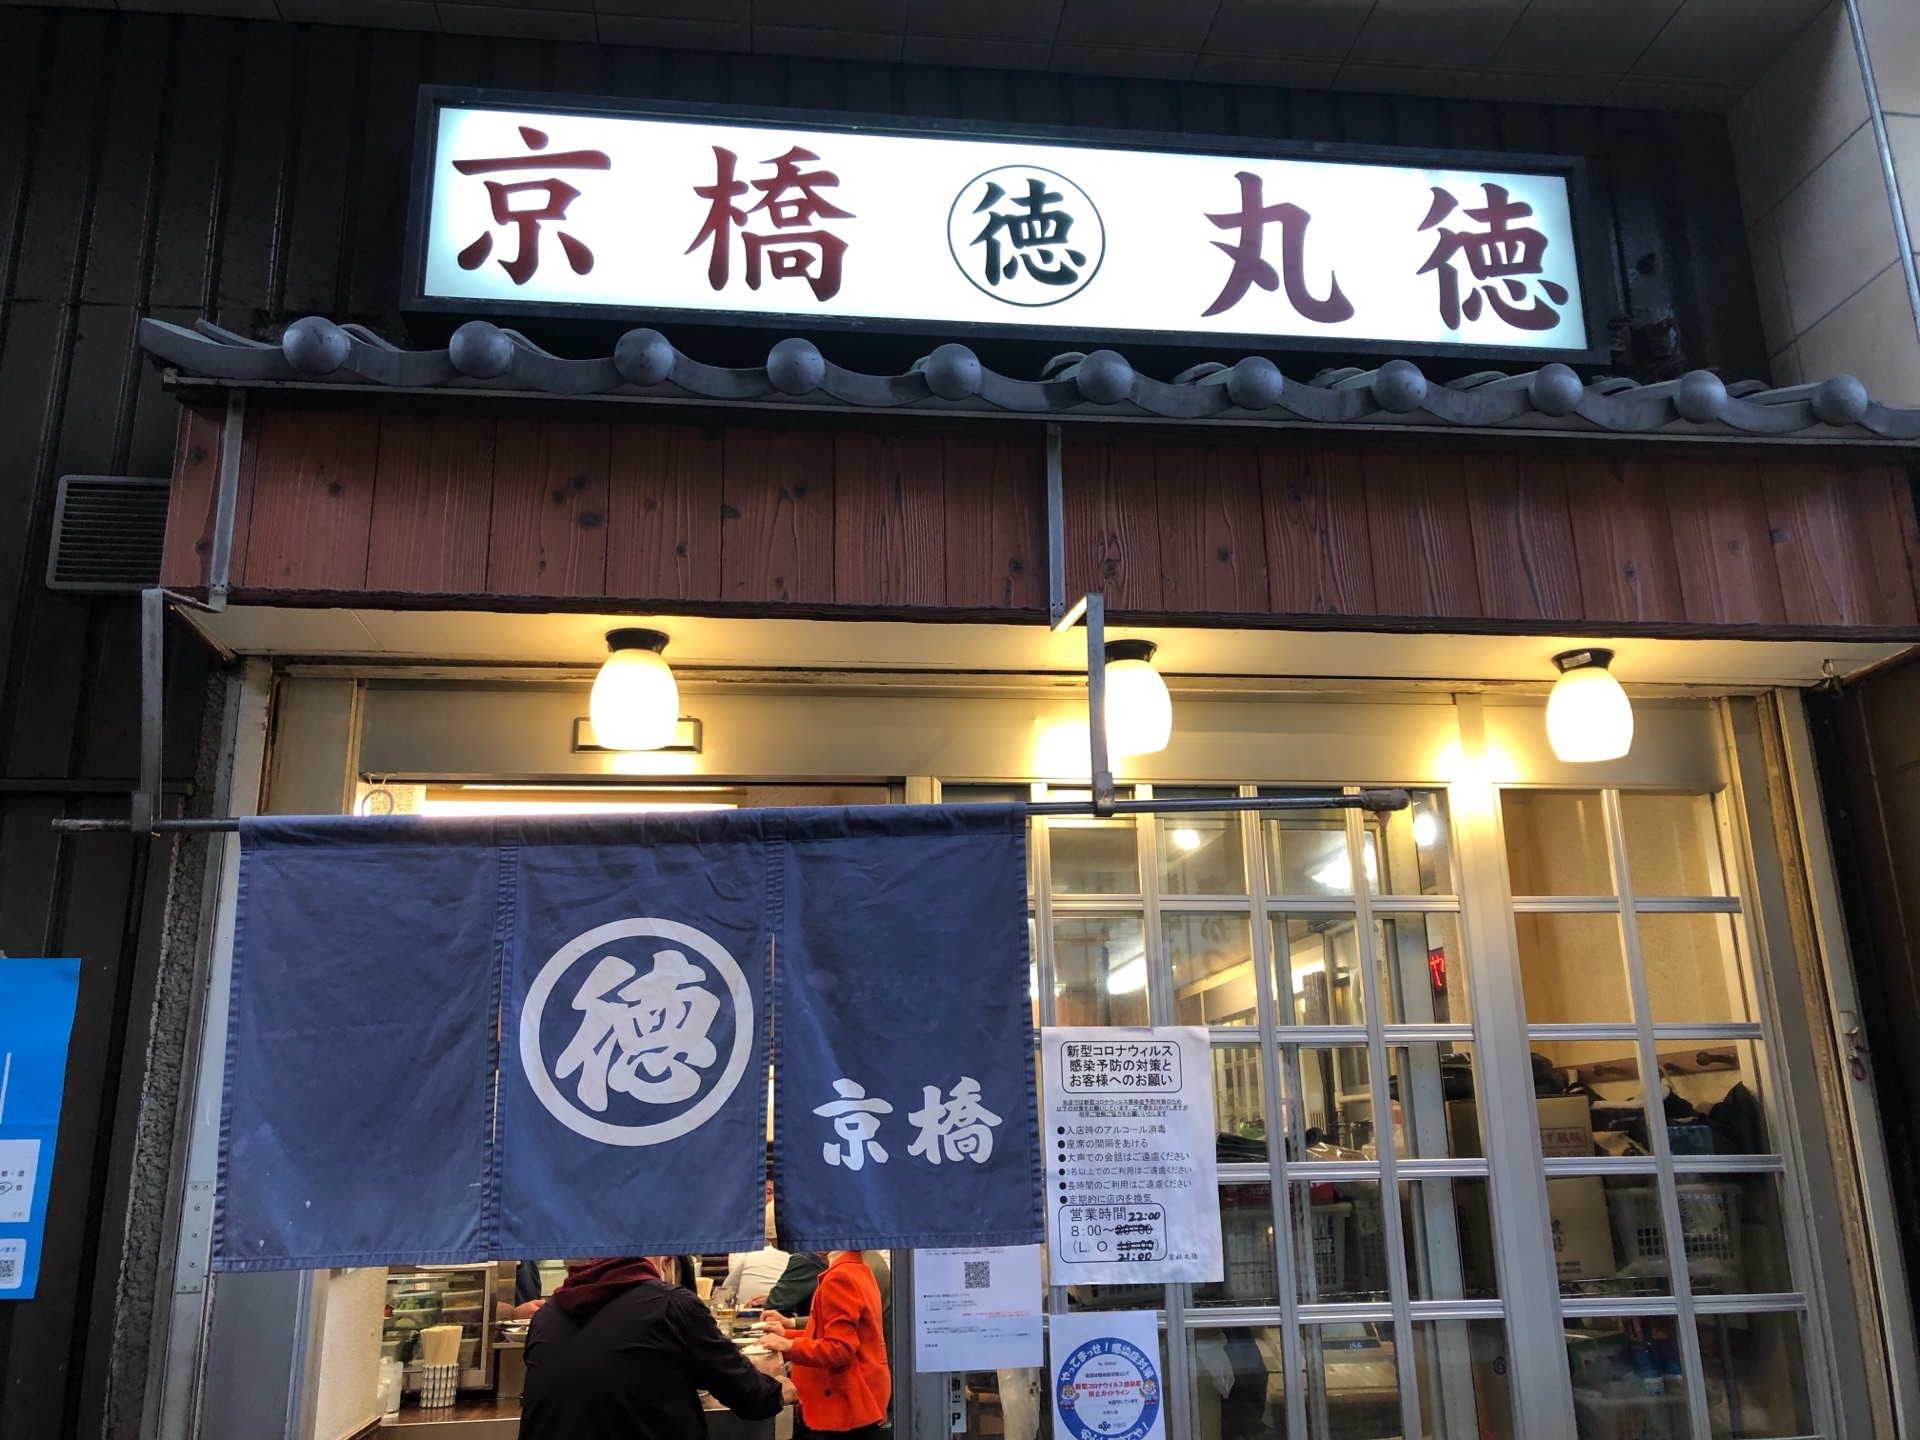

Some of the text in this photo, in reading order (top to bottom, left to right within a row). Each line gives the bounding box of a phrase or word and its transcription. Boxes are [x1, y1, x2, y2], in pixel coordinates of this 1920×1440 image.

[451, 125, 1569, 331] 京橋 徳 丸徳
[1067, 1044, 1173, 1057] 新型コロナウィルス
[1069, 1059, 1172, 1072] 感染予防の対策と
[1069, 1073, 1173, 1087] お客様へのお願い
[813, 1076, 1003, 1171] 京橋
[1066, 1124, 1166, 1135] 入店時のアルコール消毒
[1066, 1138, 1149, 1149] 座席の間隔をあける
[1067, 1151, 1190, 1163] 大声での会話はご遠慮ください
[1066, 1166, 1193, 1176] 5名以上でのご利用はご遠慮ください
[1067, 1179, 1192, 1191] 長時間のご利用はご遠慮ください
[1068, 1193, 1153, 1205] 定期的に店内を換気
[1070, 1206, 1127, 1222] 営業時間
[1127, 1211, 1161, 1222] 22:00
[1117, 1252, 1152, 1261] 21:00
